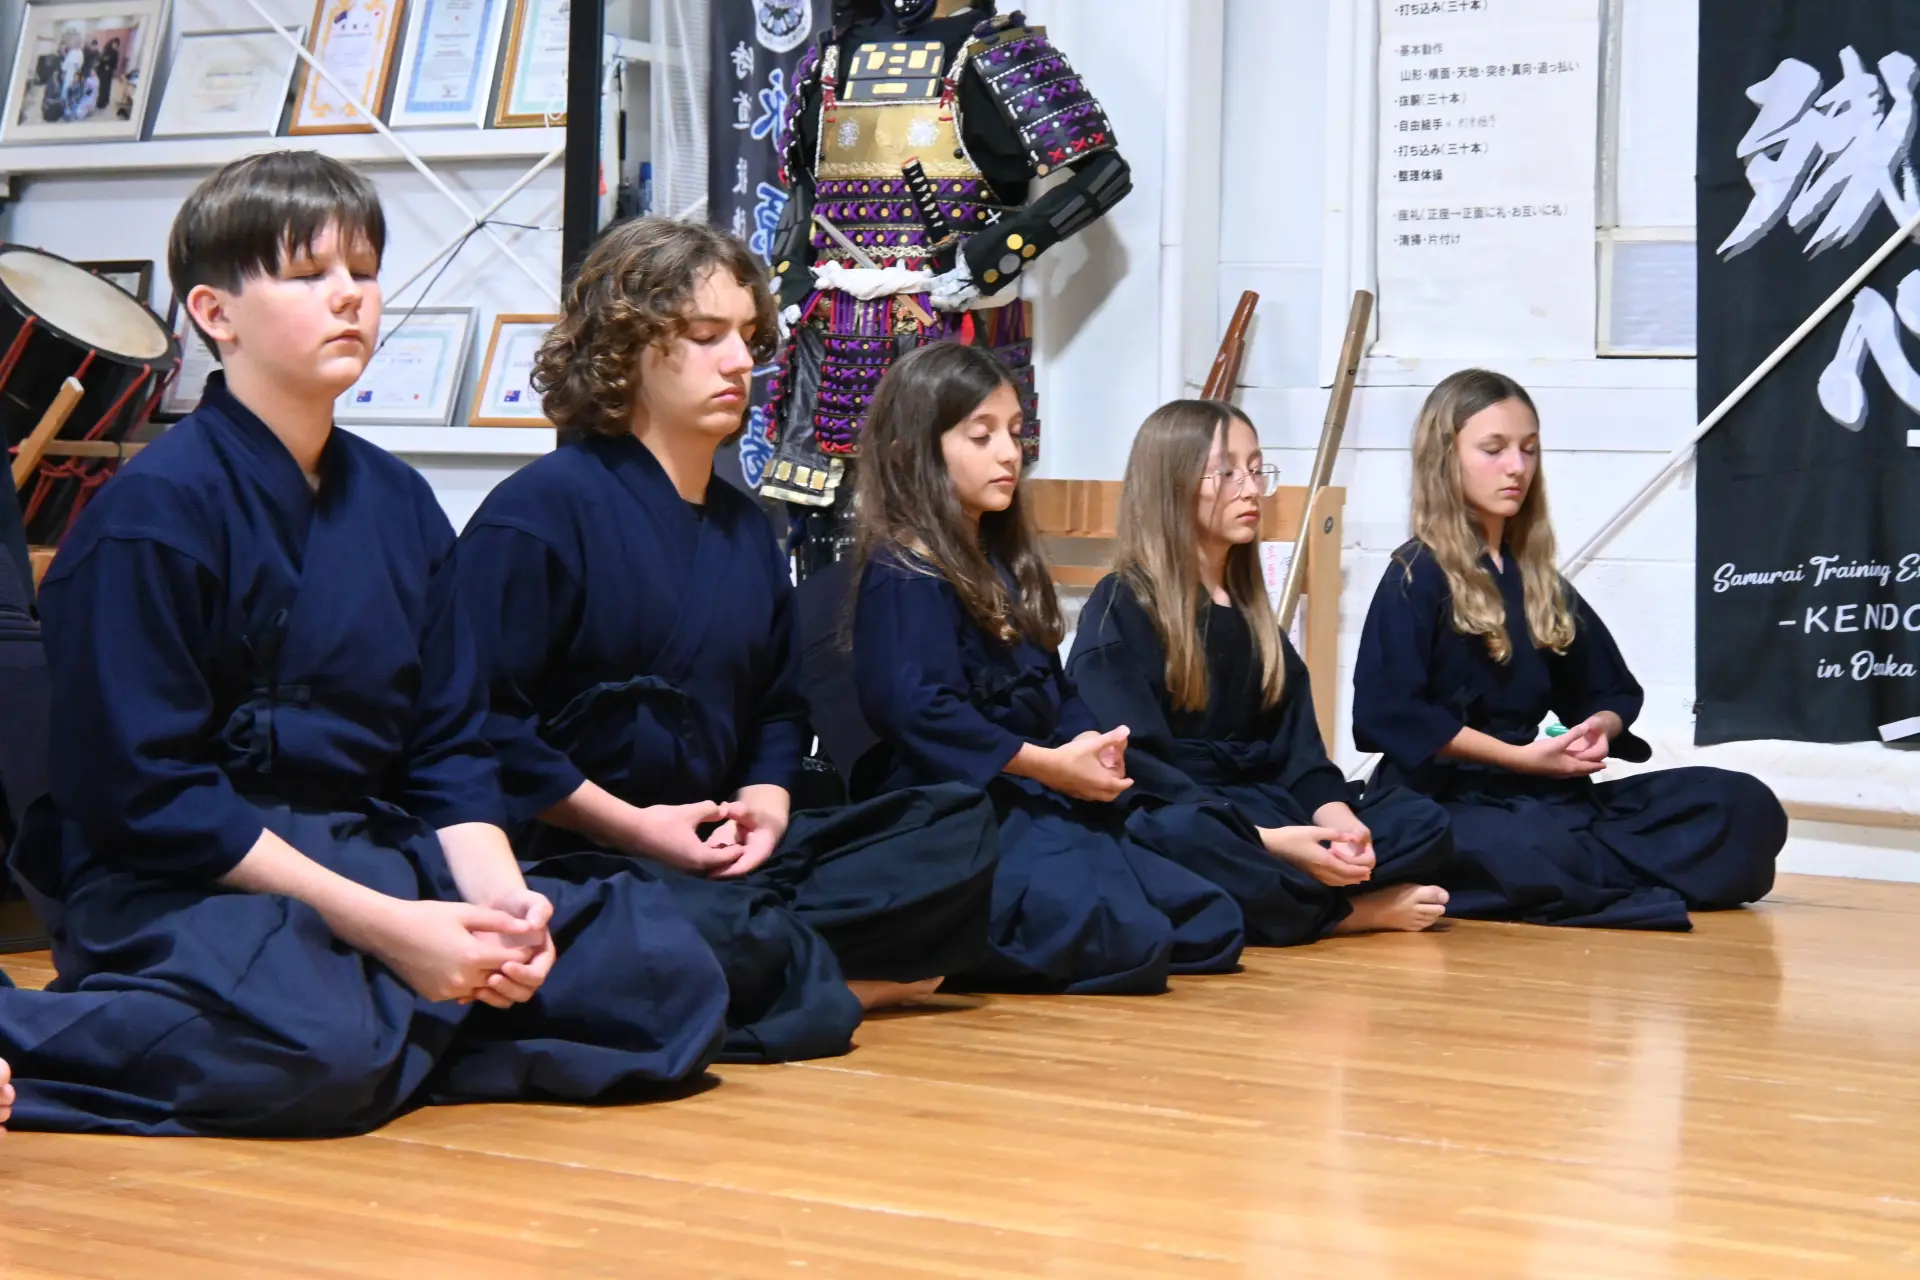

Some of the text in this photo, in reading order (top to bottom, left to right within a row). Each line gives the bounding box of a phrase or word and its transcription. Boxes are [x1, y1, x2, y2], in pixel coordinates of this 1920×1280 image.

[1713, 562, 1805, 593] Samurai
[1809, 554, 1892, 587] Training
[1816, 658, 1845, 679] in
